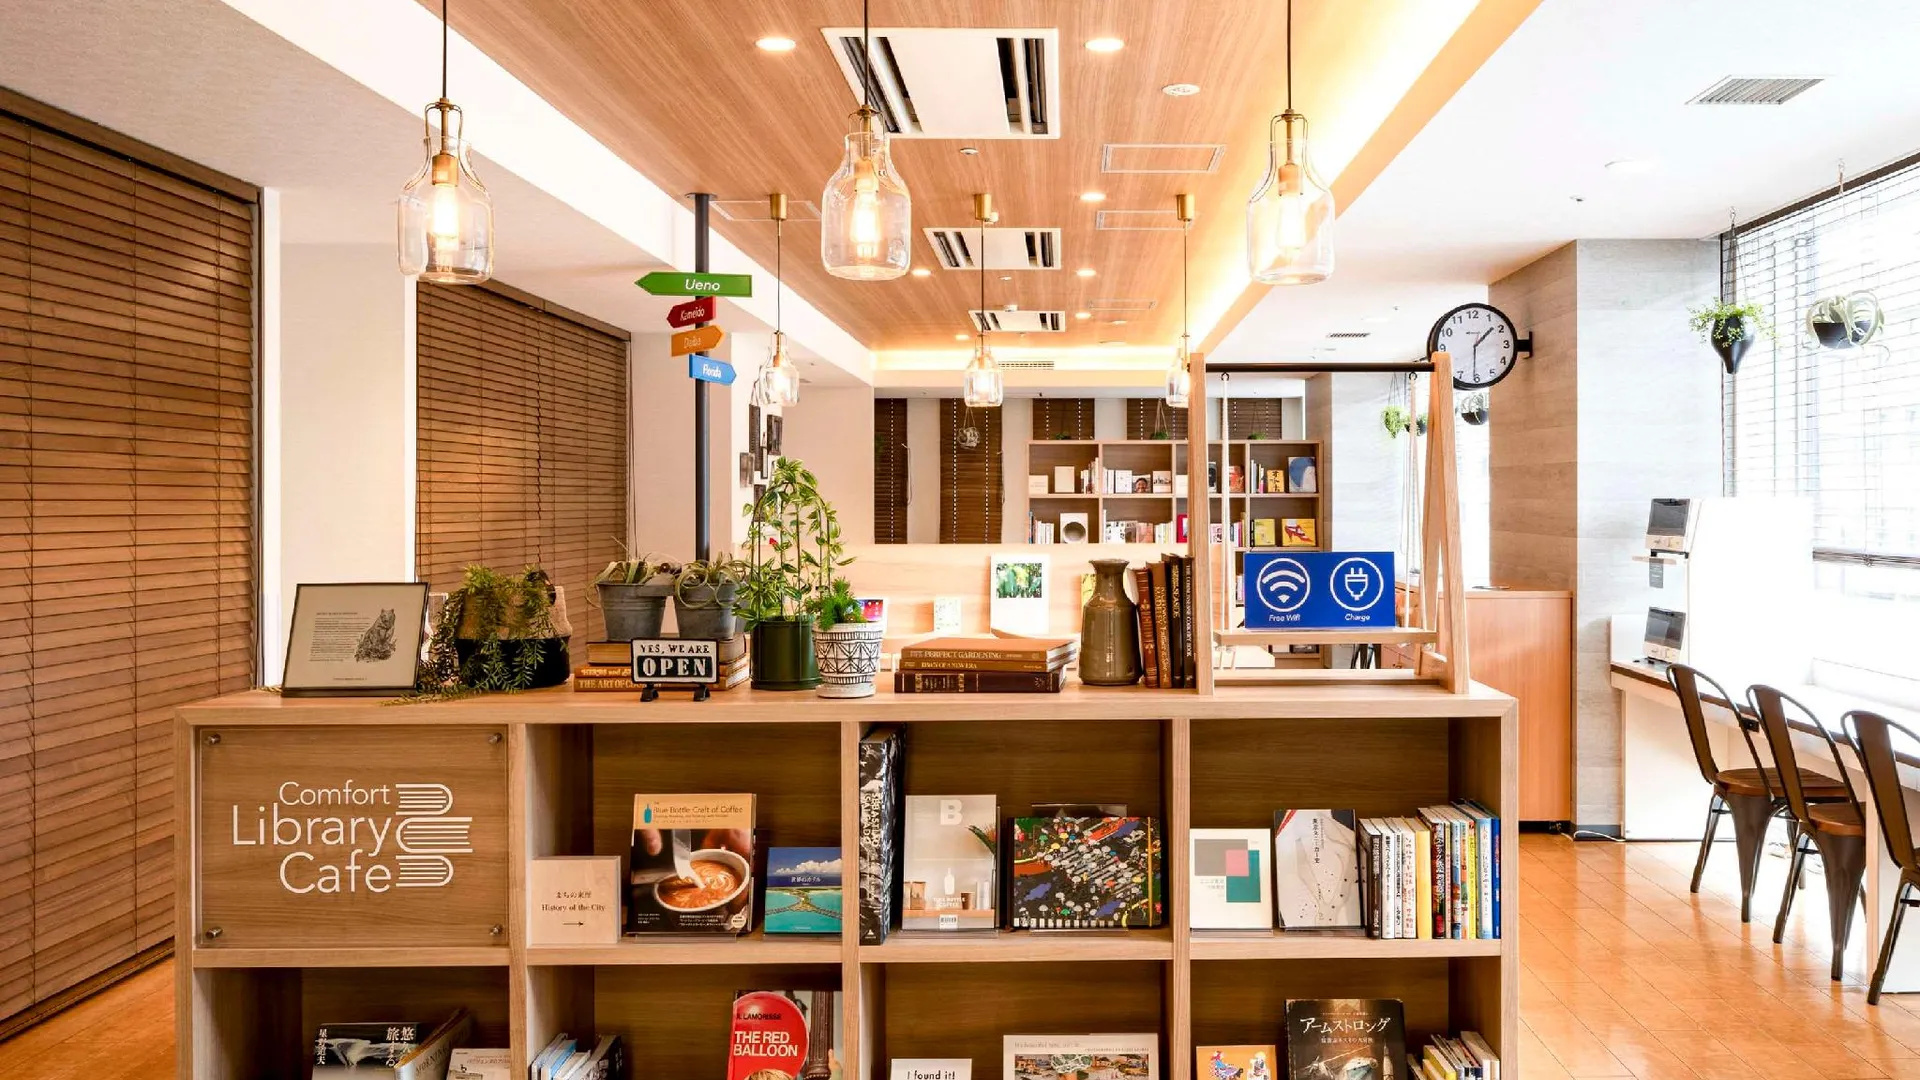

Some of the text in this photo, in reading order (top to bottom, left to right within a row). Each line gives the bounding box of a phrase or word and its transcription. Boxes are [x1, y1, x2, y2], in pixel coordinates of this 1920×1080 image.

[685, 279, 720, 291] Ueno
[680, 306, 704, 321] Kameido
[1466, 310, 1479, 319] 12
[1452, 316, 1462, 324] 11
[1441, 328, 1452, 337] 10
[1499, 325, 1504, 333] 2
[1440, 344, 1446, 352] 9
[1500, 356, 1506, 365] 4
[1457, 371, 1464, 379] 7
[1474, 374, 1480, 383] 6
[1269, 614, 1284, 622] Free
[1345, 614, 1370, 622] Charge
[641, 644, 710, 654] YES, WE ARE
[925, 651, 957, 659] PERFECT
[958, 651, 1001, 659] GARDENING
[643, 658, 706, 676] OPEN
[579, 680, 596, 688] THE
[597, 680, 612, 688] ART
[614, 680, 625, 688] OF
[279, 780, 390, 806] Comfort
[721, 805, 742, 813] Coffee
[940, 800, 962, 825] B
[233, 803, 392, 857] Library
[280, 849, 391, 893] Cafe
[542, 904, 566, 912] History
[1300, 1017, 1391, 1034] アームストロング
[735, 1031, 790, 1043] THE RED
[316, 1028, 328, 1065] 星野道夫
[385, 1027, 400, 1067] 旅する
[734, 1044, 798, 1056] BALLOON
[907, 1070, 955, 1080] I found it!
